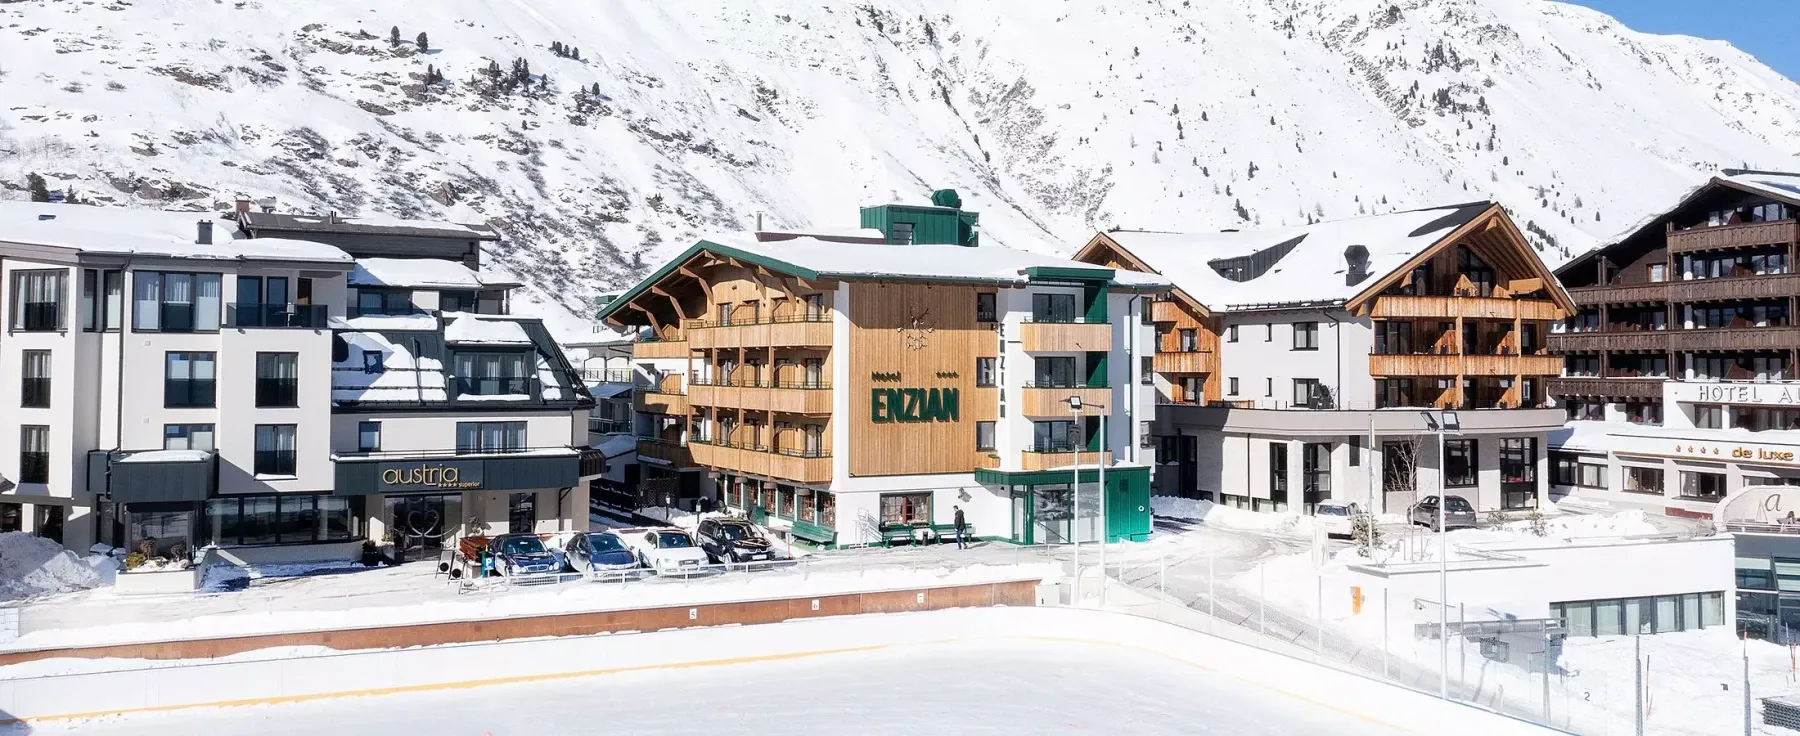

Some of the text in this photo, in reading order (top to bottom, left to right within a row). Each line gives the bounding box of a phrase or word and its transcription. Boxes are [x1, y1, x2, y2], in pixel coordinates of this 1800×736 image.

[871, 370, 902, 383] Hotel
[1698, 385, 1763, 403] HOTEL
[871, 387, 960, 424] ENZIAN
[1731, 446, 1794, 461] de luxe
[382, 463, 458, 486] austria
[1584, 691, 1591, 702] 2
